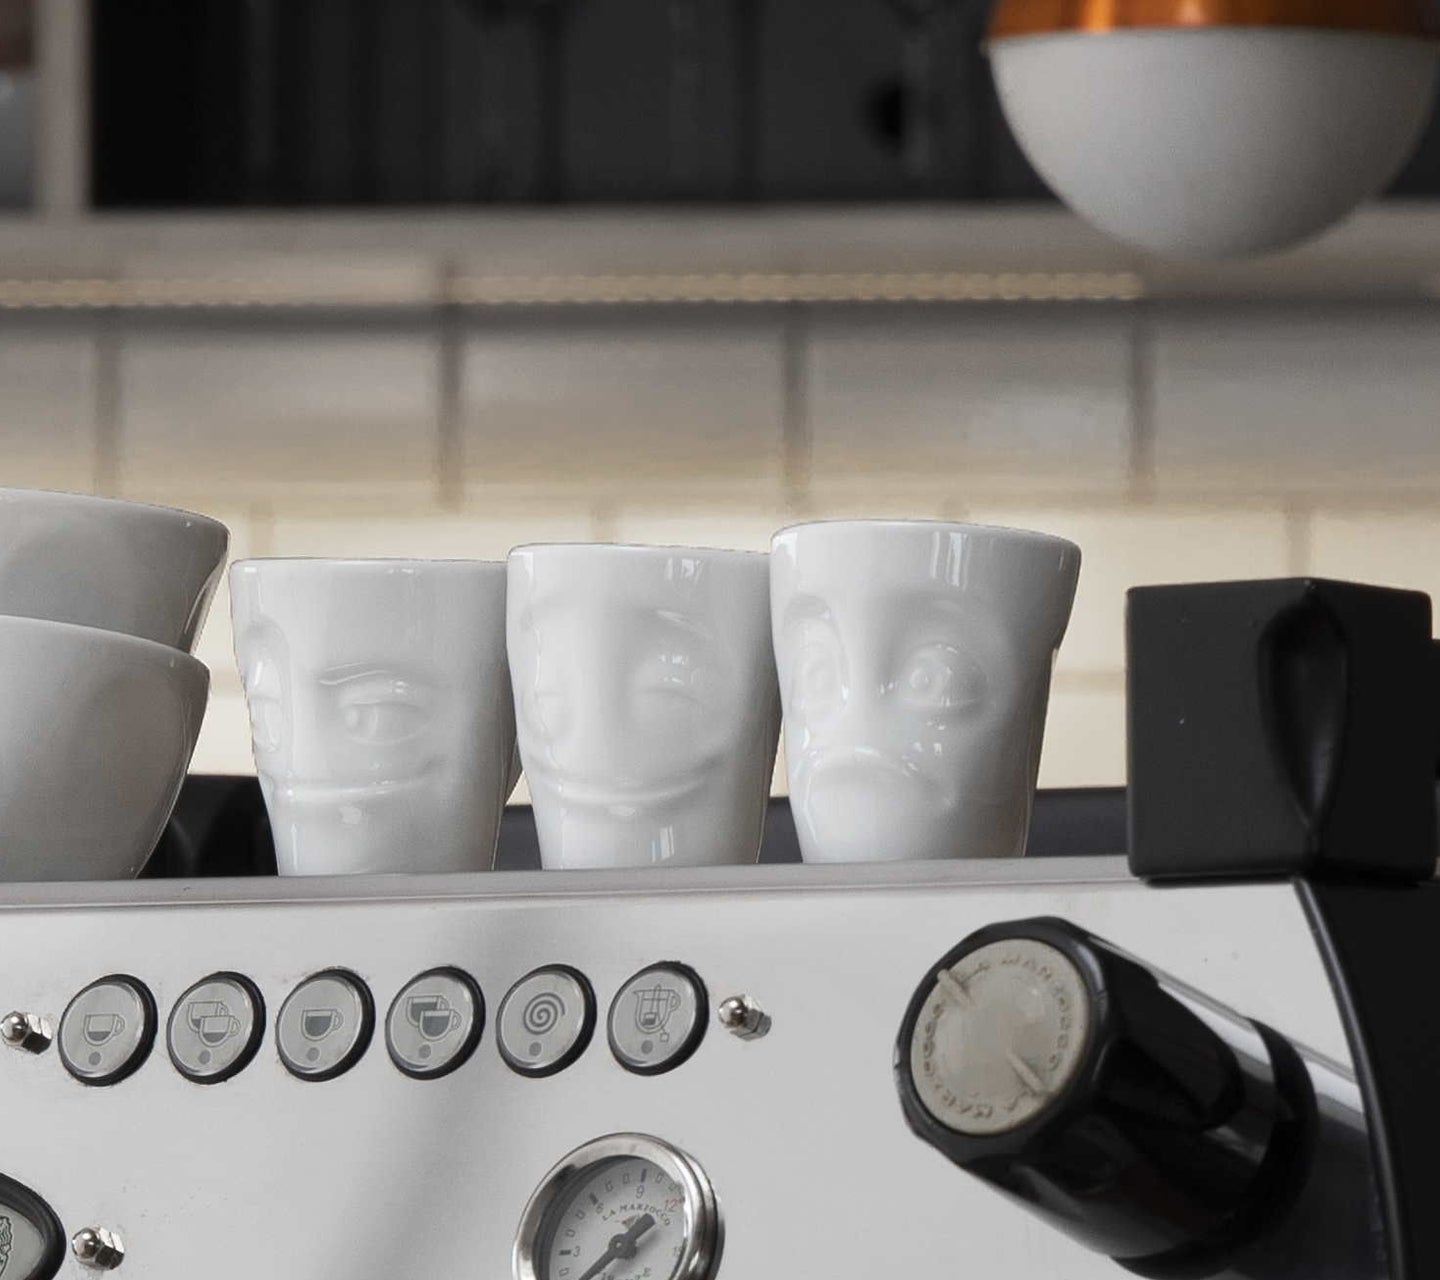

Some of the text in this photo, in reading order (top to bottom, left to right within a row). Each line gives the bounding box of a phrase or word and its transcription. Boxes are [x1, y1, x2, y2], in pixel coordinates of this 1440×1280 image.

[636, 1184, 645, 1198] 9
[620, 1204, 670, 1226] MARZOCCO
[573, 1245, 581, 1258] 3
